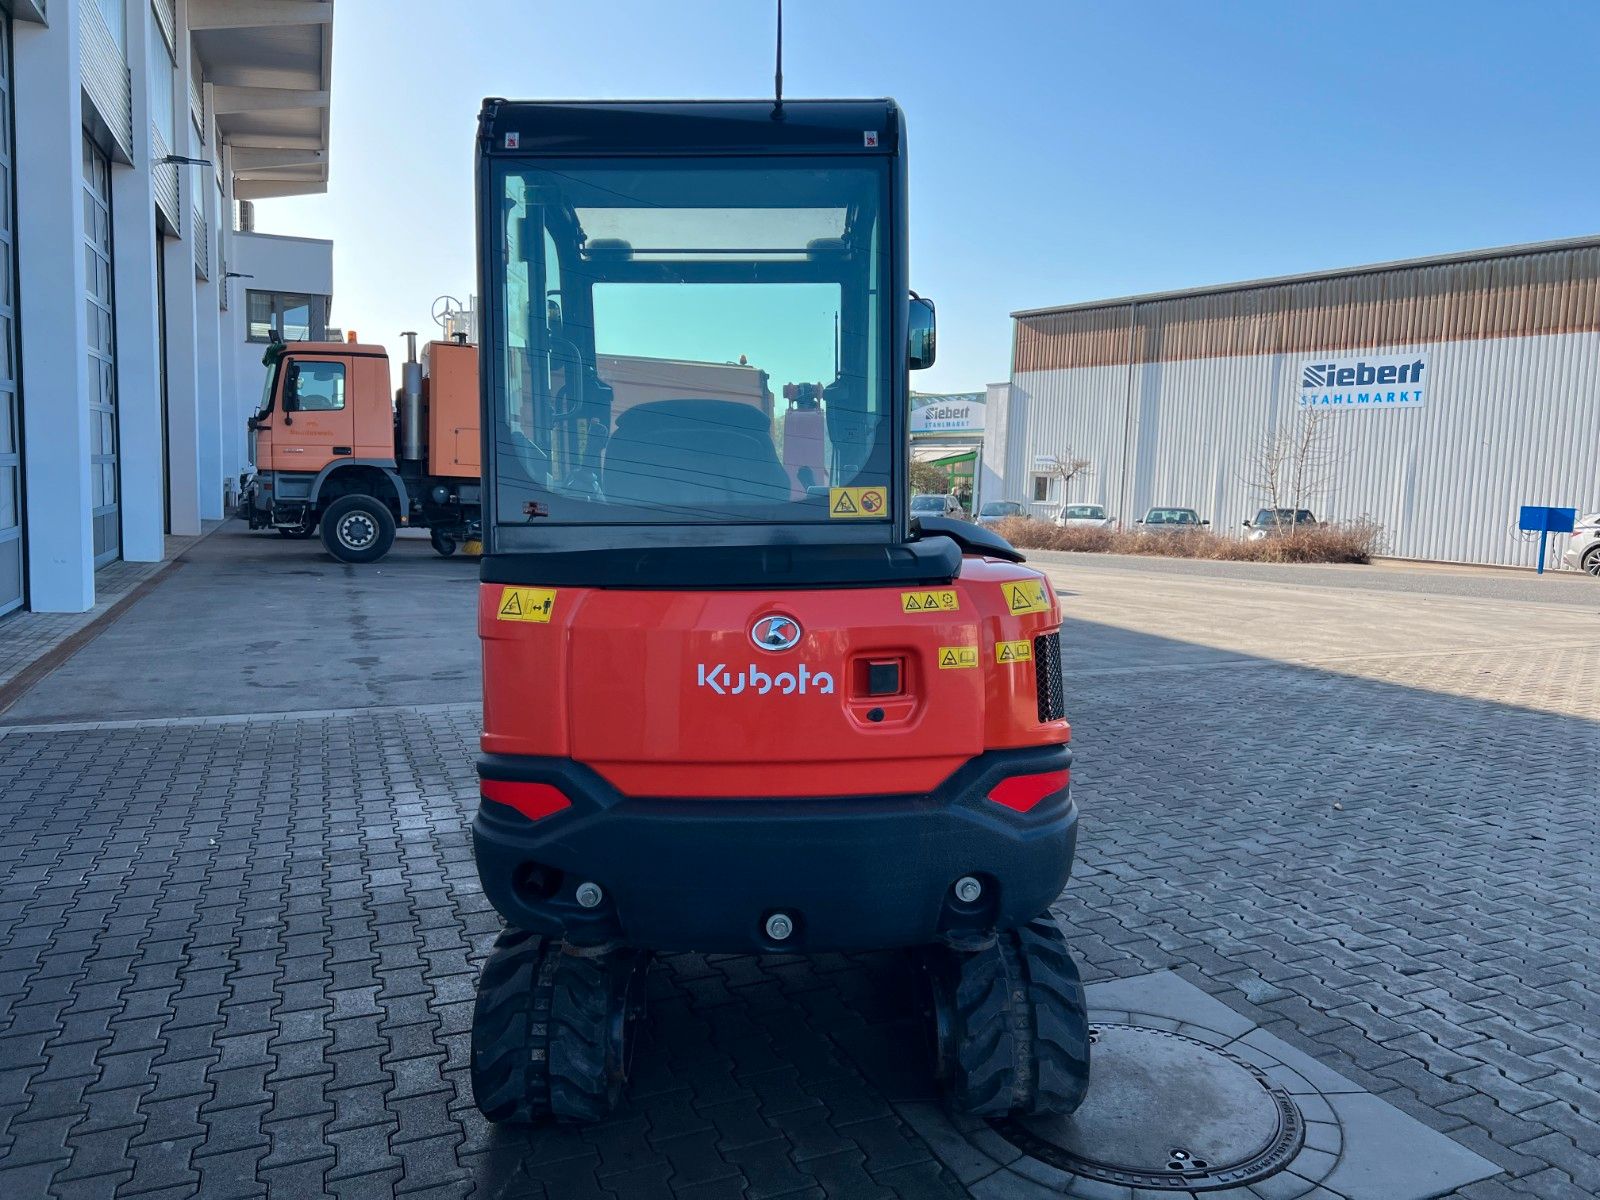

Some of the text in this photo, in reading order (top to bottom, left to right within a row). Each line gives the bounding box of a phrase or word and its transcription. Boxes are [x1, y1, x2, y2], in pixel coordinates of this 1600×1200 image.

[1302, 359, 1425, 388] Siebert
[1301, 390, 1423, 405] STAHLMARKT
[925, 406, 970, 420] Siebert
[697, 663, 834, 695] Kubota
